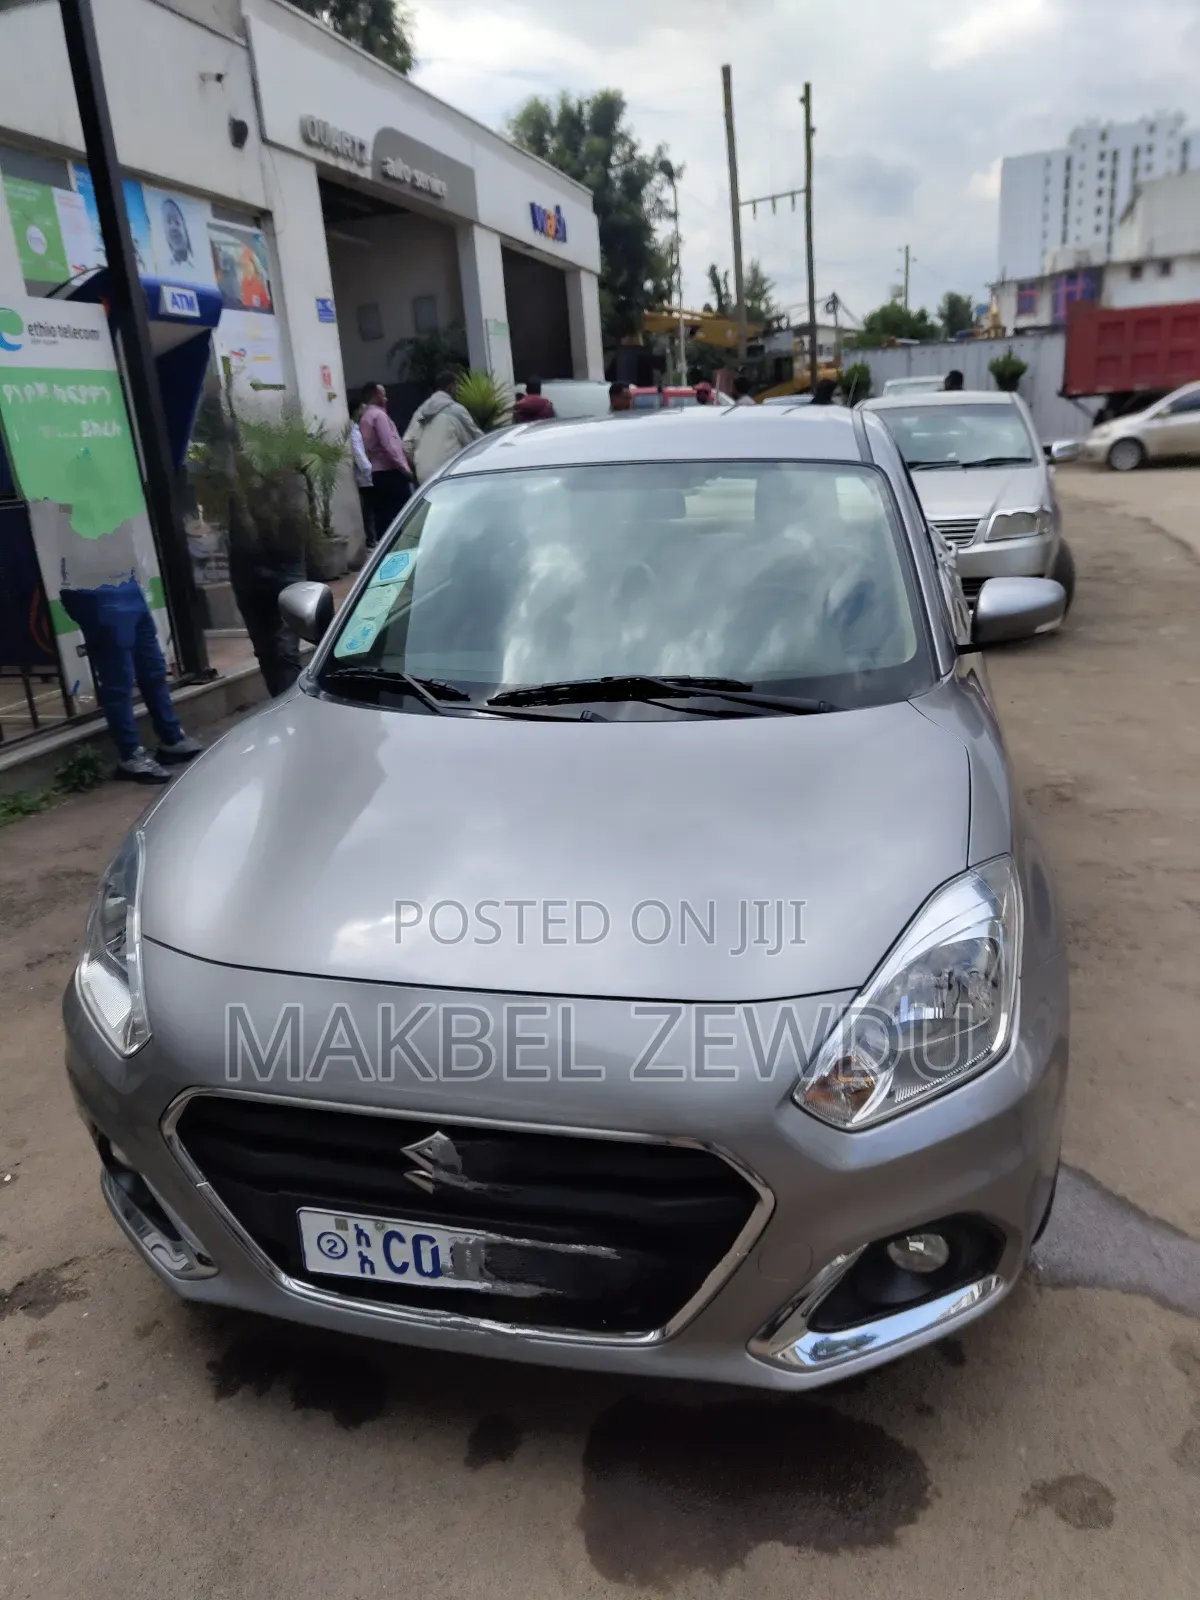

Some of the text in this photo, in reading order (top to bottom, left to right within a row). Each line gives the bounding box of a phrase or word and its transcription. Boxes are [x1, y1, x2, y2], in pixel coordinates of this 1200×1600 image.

[171, 291, 196, 312] ATM
[28, 321, 100, 341] ethio telecom
